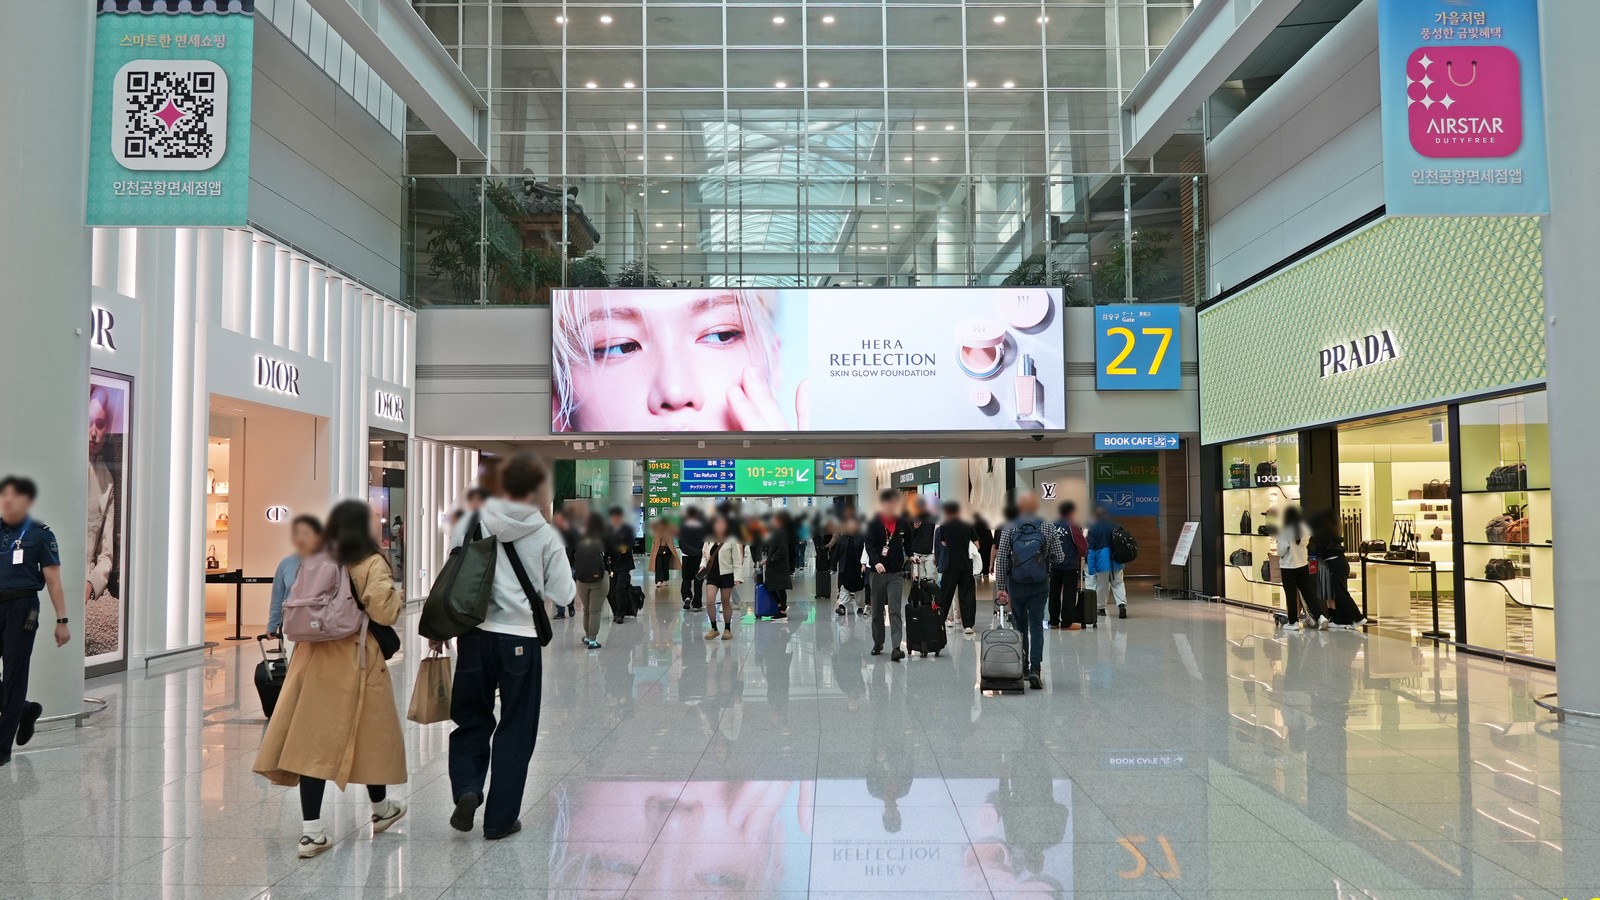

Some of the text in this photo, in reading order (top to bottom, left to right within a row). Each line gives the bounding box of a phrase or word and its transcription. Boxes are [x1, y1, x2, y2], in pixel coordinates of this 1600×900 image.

[1434, 12, 1486, 26] 가을처럼
[120, 34, 226, 48] 스마트한 면세쇼핑
[1420, 28, 1502, 40] 풍성한 금빛혜택
[1426, 118, 1504, 134] AIRSTAR
[1412, 169, 1523, 184] 인천공항면세점앱
[113, 181, 222, 196] 인천공항면세점앱
[862, 340, 904, 350] HERA
[1106, 326, 1173, 375] 27
[830, 354, 936, 366] REFLECTION
[1319, 330, 1397, 378] PRADA
[257, 356, 300, 396] DIOR
[376, 391, 405, 421] DIOR
[1104, 438, 1152, 446] BOOK CAFE
